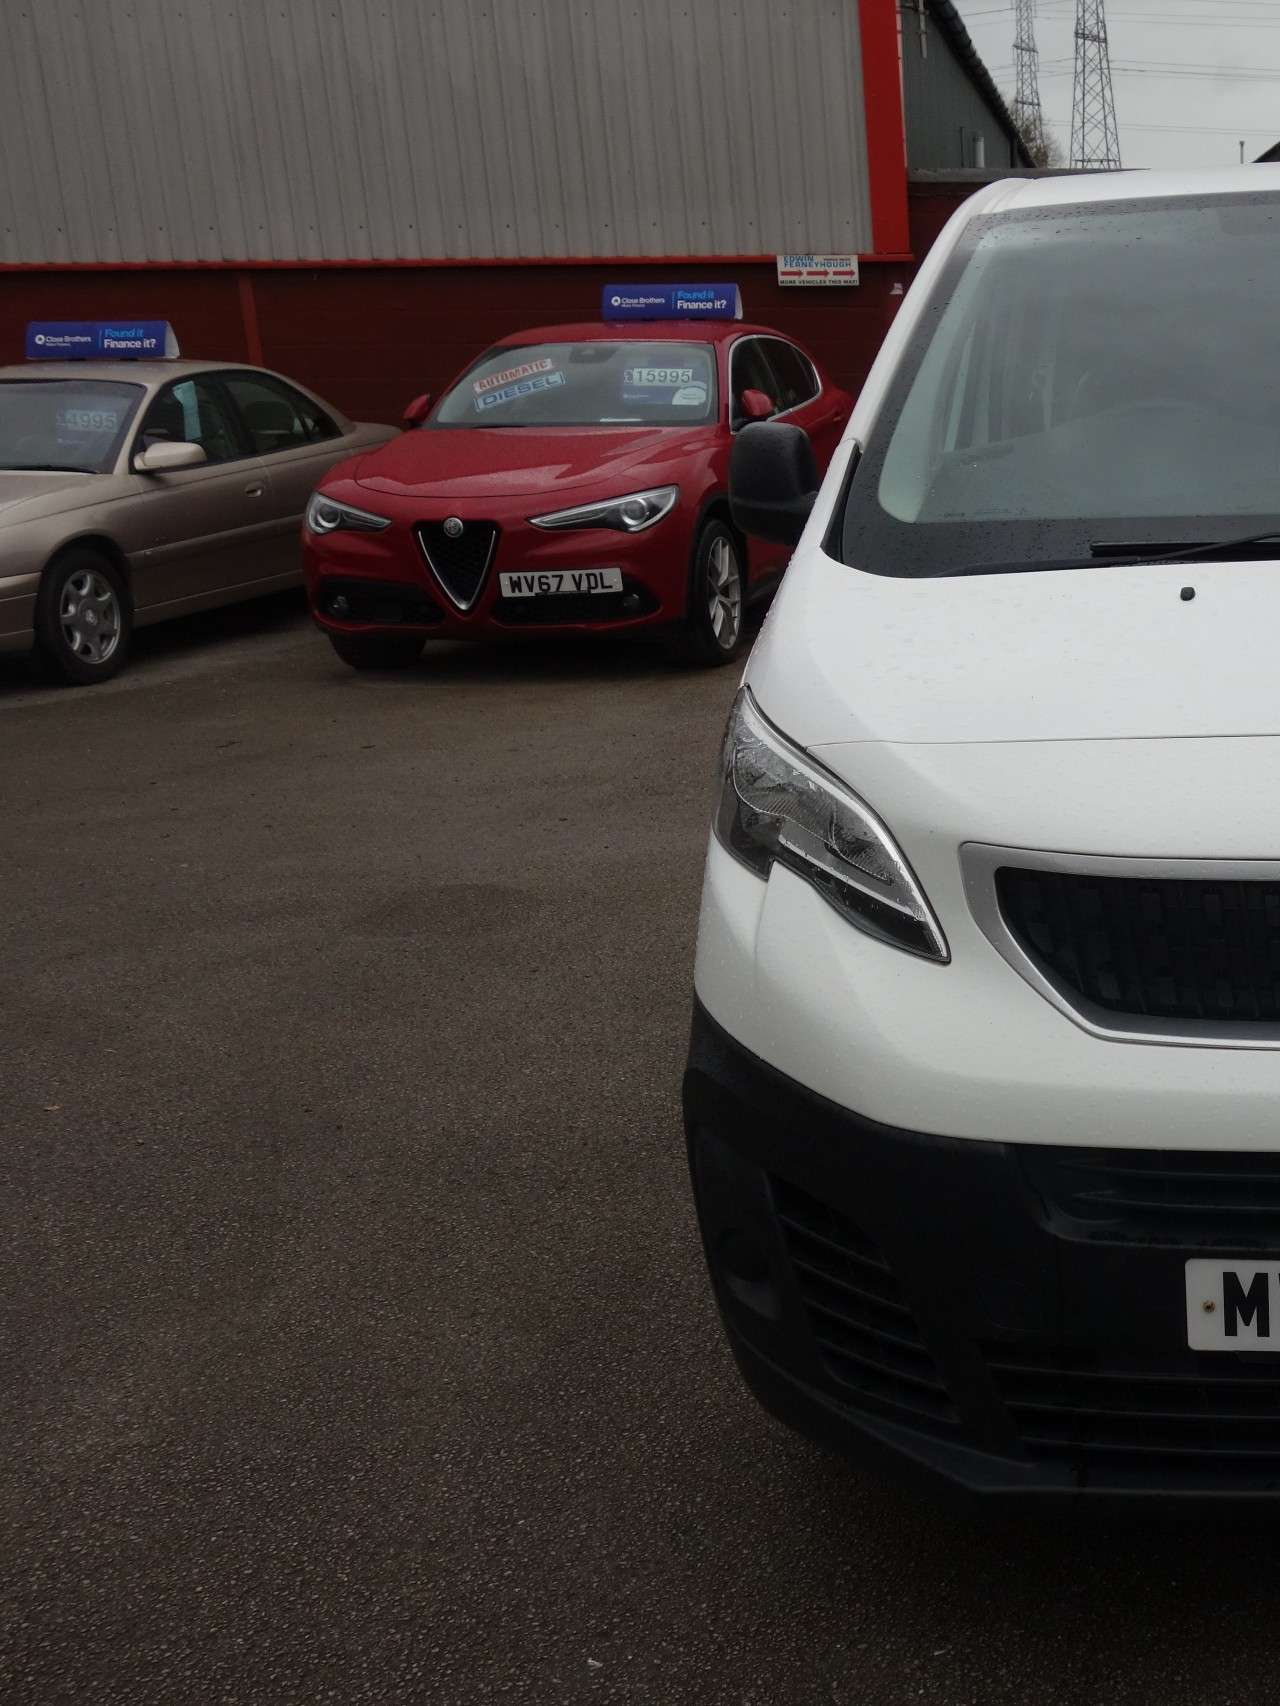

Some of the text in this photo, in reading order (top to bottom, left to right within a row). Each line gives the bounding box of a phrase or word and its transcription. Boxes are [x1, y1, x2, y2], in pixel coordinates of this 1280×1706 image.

[677, 289, 704, 299] Found
[677, 299, 727, 310] Finance it?
[104, 328, 135, 337] Found
[103, 338, 157, 349] Finance it?
[479, 360, 547, 389] AUTOMATIC
[483, 376, 559, 406] DIESEL
[508, 572, 613, 594] WV67 VDL
